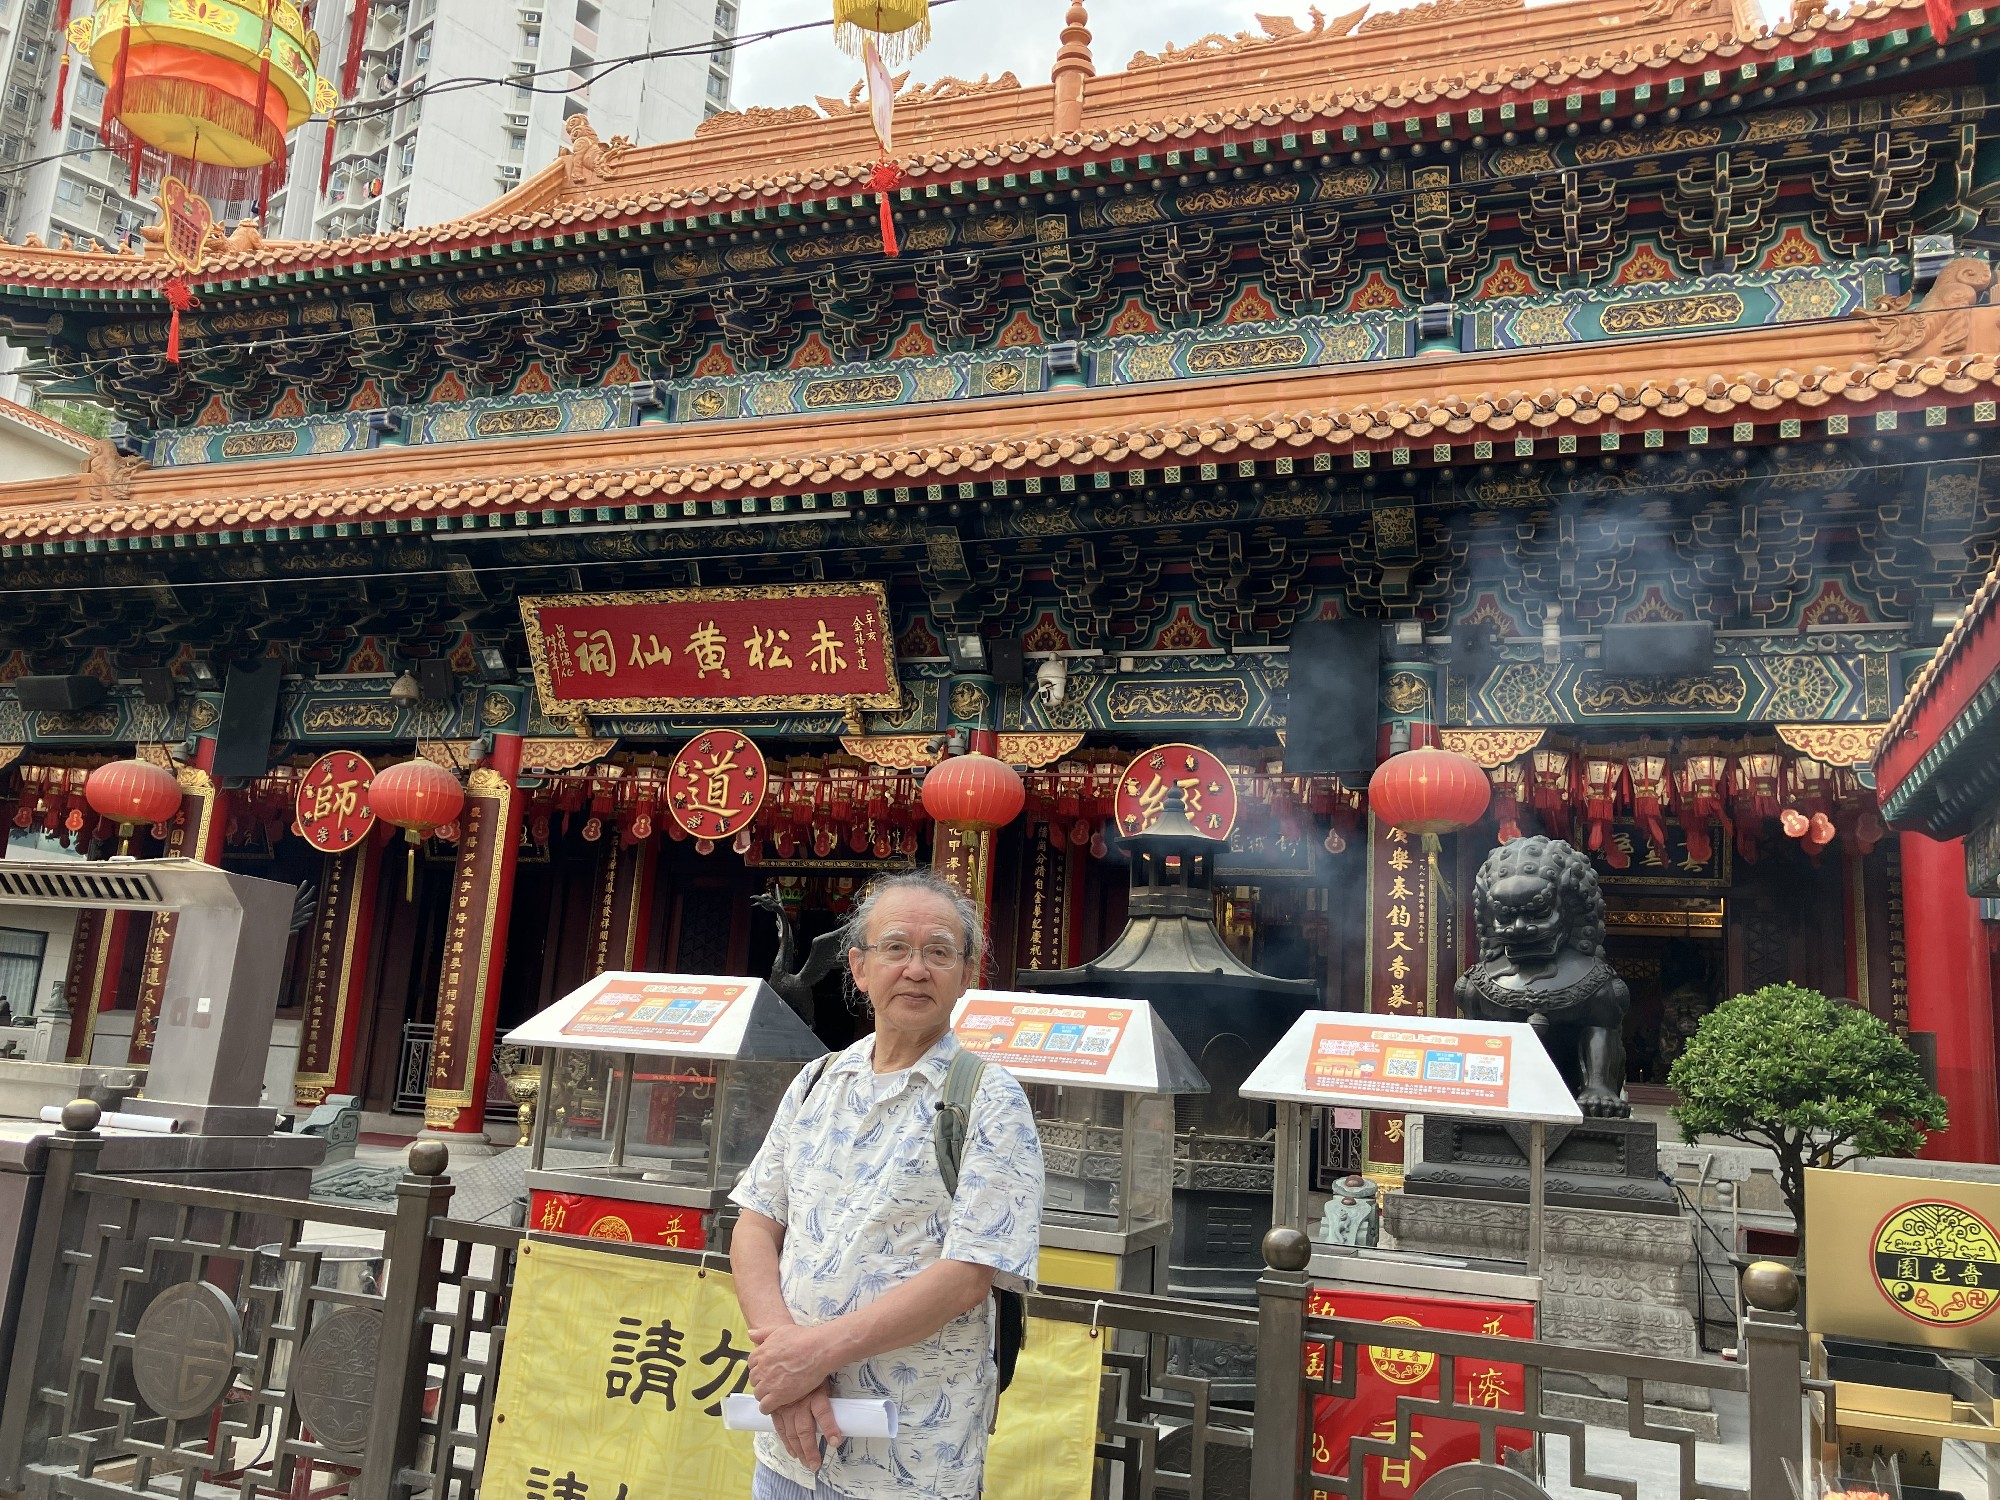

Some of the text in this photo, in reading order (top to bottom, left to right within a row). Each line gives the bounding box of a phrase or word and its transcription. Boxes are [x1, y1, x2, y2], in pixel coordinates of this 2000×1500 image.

[313, 772, 360, 830] 師
[686, 749, 742, 817] 道
[540, 1197, 566, 1232] 勸
[657, 1213, 686, 1248] 普
